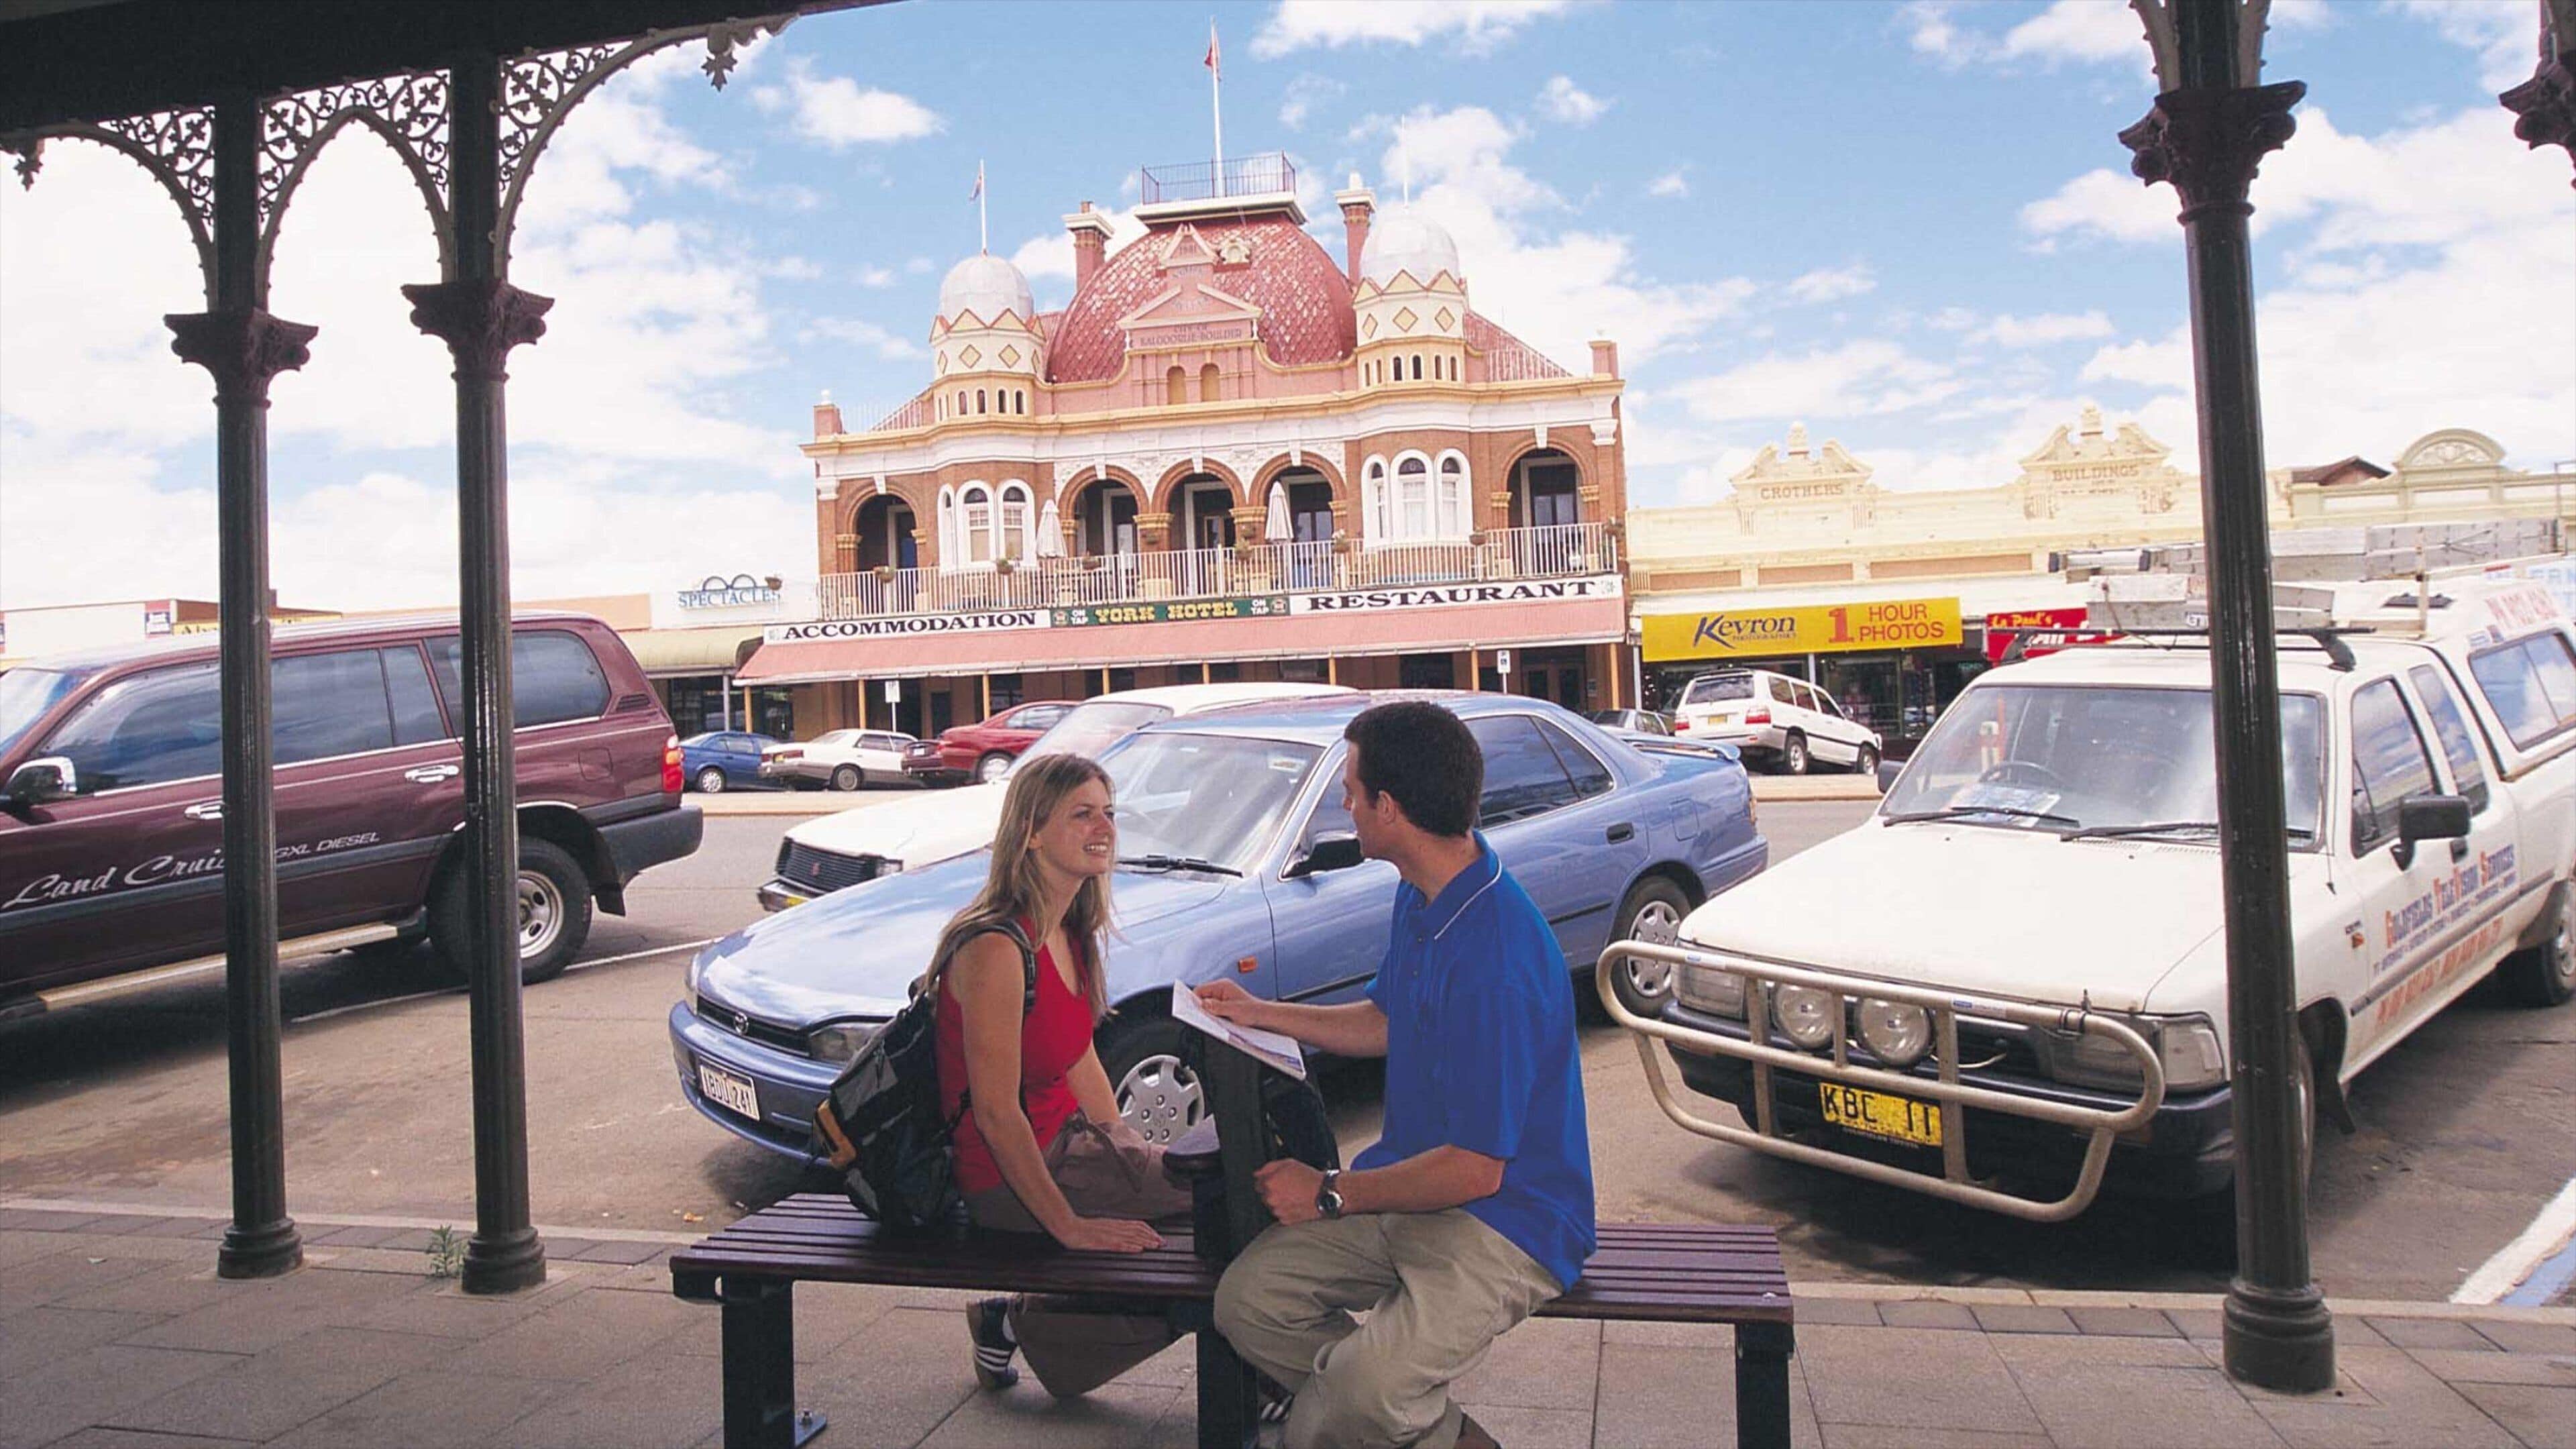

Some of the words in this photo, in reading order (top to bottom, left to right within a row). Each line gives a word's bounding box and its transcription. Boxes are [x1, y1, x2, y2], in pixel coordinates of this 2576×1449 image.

[2052, 464, 2139, 482] BUILDINGS
[1760, 482, 1844, 500] CROTHERS
[678, 588, 781, 608] SPECTACLES
[1308, 581, 1595, 611] RESTAURANT
[1071, 616, 1089, 625] TAP
[1072, 609, 1085, 618] ON
[1095, 606, 1155, 623] YORK
[1167, 602, 1238, 620] HOTEL
[1251, 606, 1269, 615] TAP
[784, 612, 1036, 639] ACCOMMODATION
[1693, 614, 1796, 649] Kevron
[1828, 608, 1855, 643] 1
[1869, 604, 1927, 623] HOUR
[1860, 621, 1945, 642] PHOTOS
[275, 843, 311, 859] GXL
[317, 831, 380, 851] DIESEL
[1, 867, 117, 910] Land
[124, 848, 224, 884] Crui
[1823, 1085, 1878, 1123] KBC
